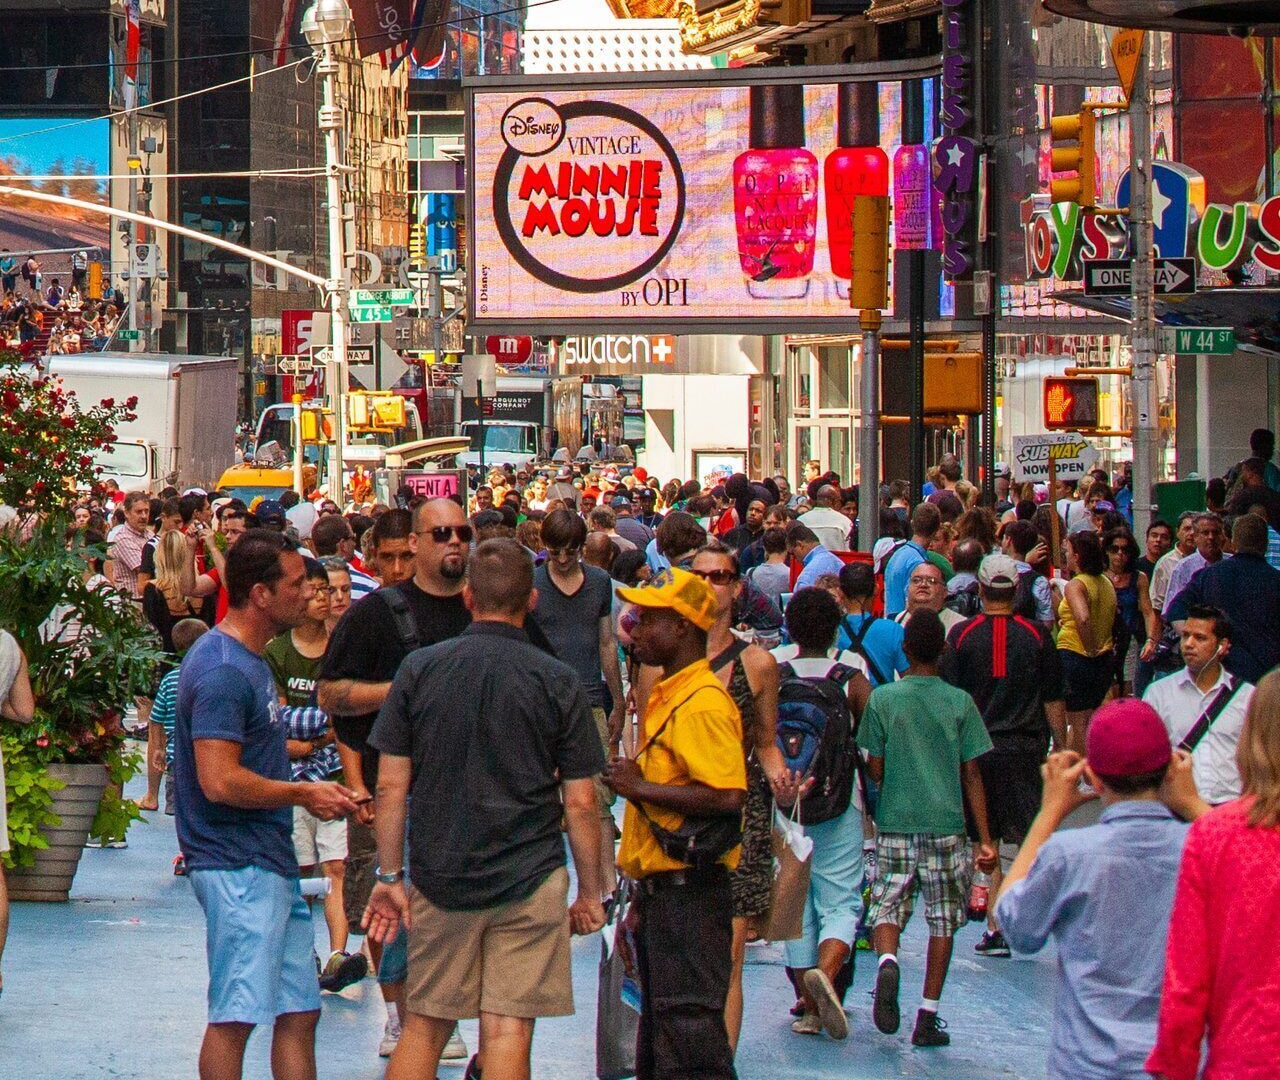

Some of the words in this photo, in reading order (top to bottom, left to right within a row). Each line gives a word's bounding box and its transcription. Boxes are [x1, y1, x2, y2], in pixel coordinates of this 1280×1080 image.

[509, 116, 560, 139] Disney
[566, 135, 641, 156] VINTAGE
[518, 159, 665, 201] MINNIE
[521, 197, 660, 238] MOUSE
[480, 264, 489, 302] Disney
[1100, 270, 1130, 285] ONE
[358, 290, 384, 301] GEORGE
[620, 290, 640, 306] BY
[642, 278, 690, 307] OPI
[351, 308, 362, 321] W
[365, 309, 381, 321] 45
[1180, 332, 1191, 351] W
[1196, 332, 1214, 351] 44
[1219, 330, 1231, 341] ST
[347, 351, 365, 360] WAY
[1017, 441, 1088, 464] SUBWAY
[1023, 464, 1049, 475] NOW
[1054, 462, 1084, 474] OPEN
[441, 479, 452, 495] A
